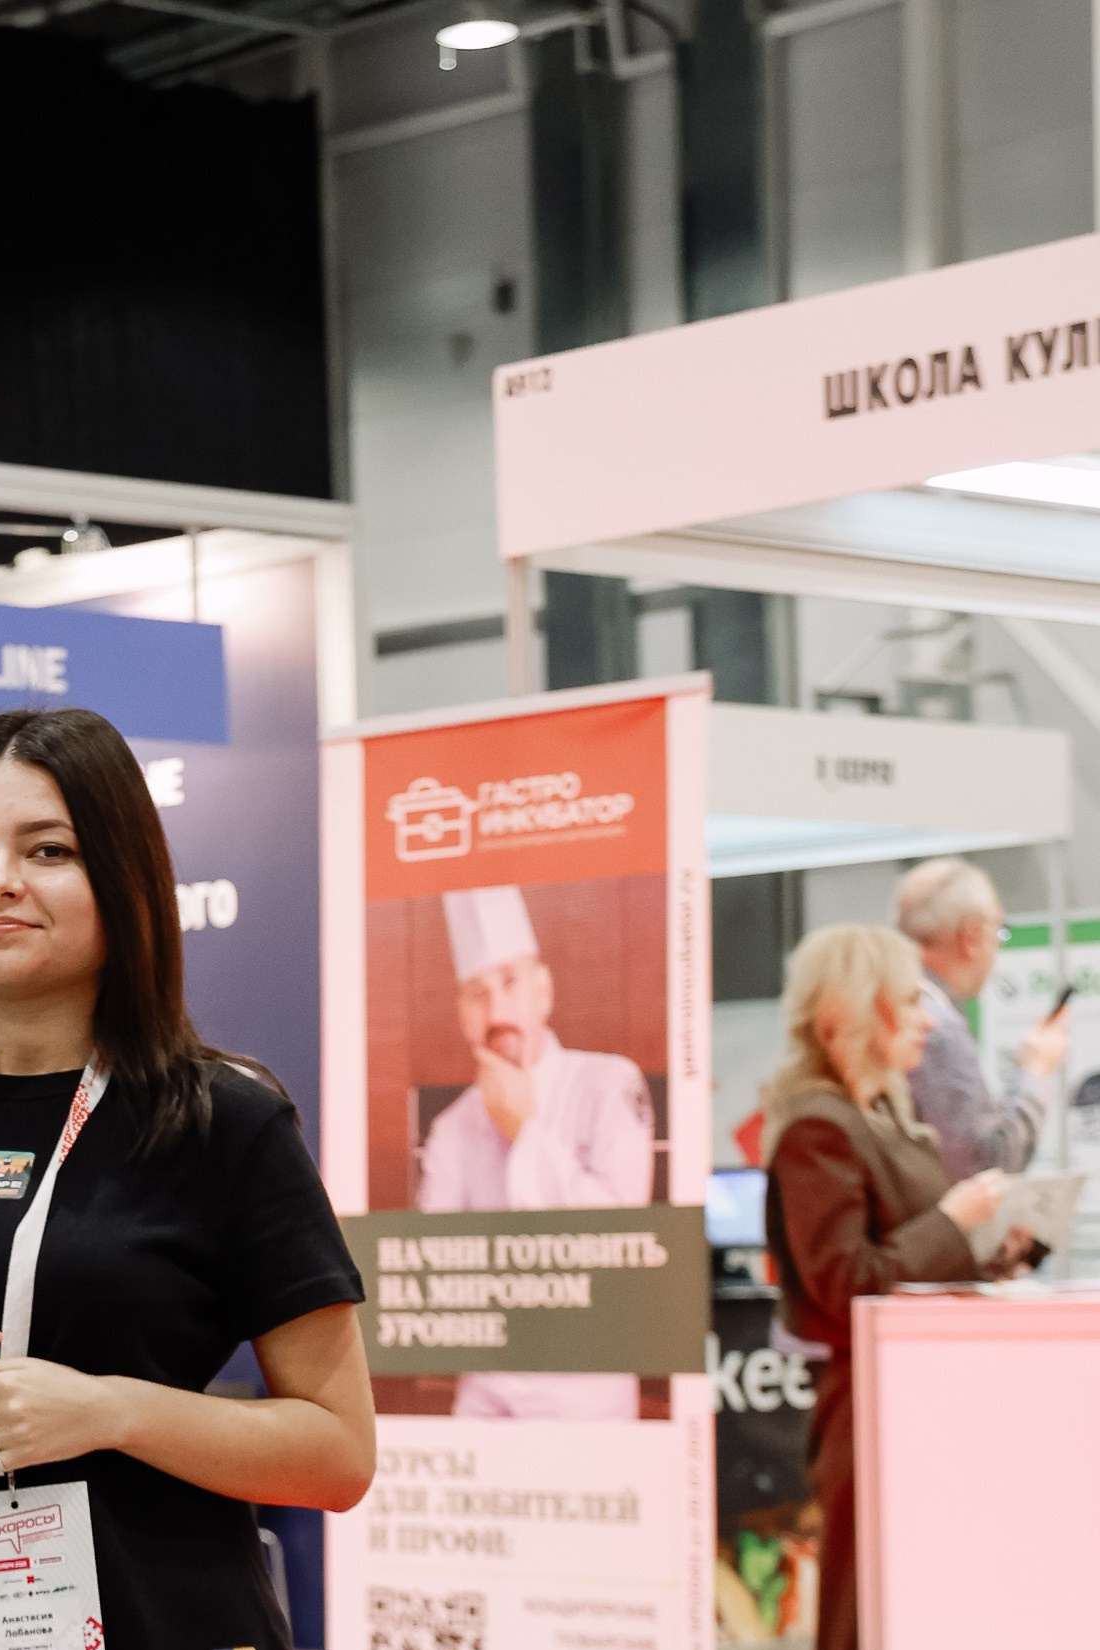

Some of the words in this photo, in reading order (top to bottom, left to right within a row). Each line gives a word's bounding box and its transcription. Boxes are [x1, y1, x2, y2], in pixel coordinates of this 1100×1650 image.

[823, 346, 983, 420] ШКОЛА
[1005, 316, 1100, 383] КУЛ
[478, 771, 581, 802] ГАСТРО
[377, 1236, 489, 1271] НАЧНИ
[493, 1232, 669, 1270] ГОТОВИТЬ
[377, 1274, 424, 1309] НА
[426, 1272, 592, 1308] МИРОВОМ
[377, 1312, 508, 1347] УРОВНЕ
[376, 1447, 477, 1477] УРСЫ
[2, 1613, 53, 1624] Анастасия
[5, 1627, 53, 1638] Лобанова
